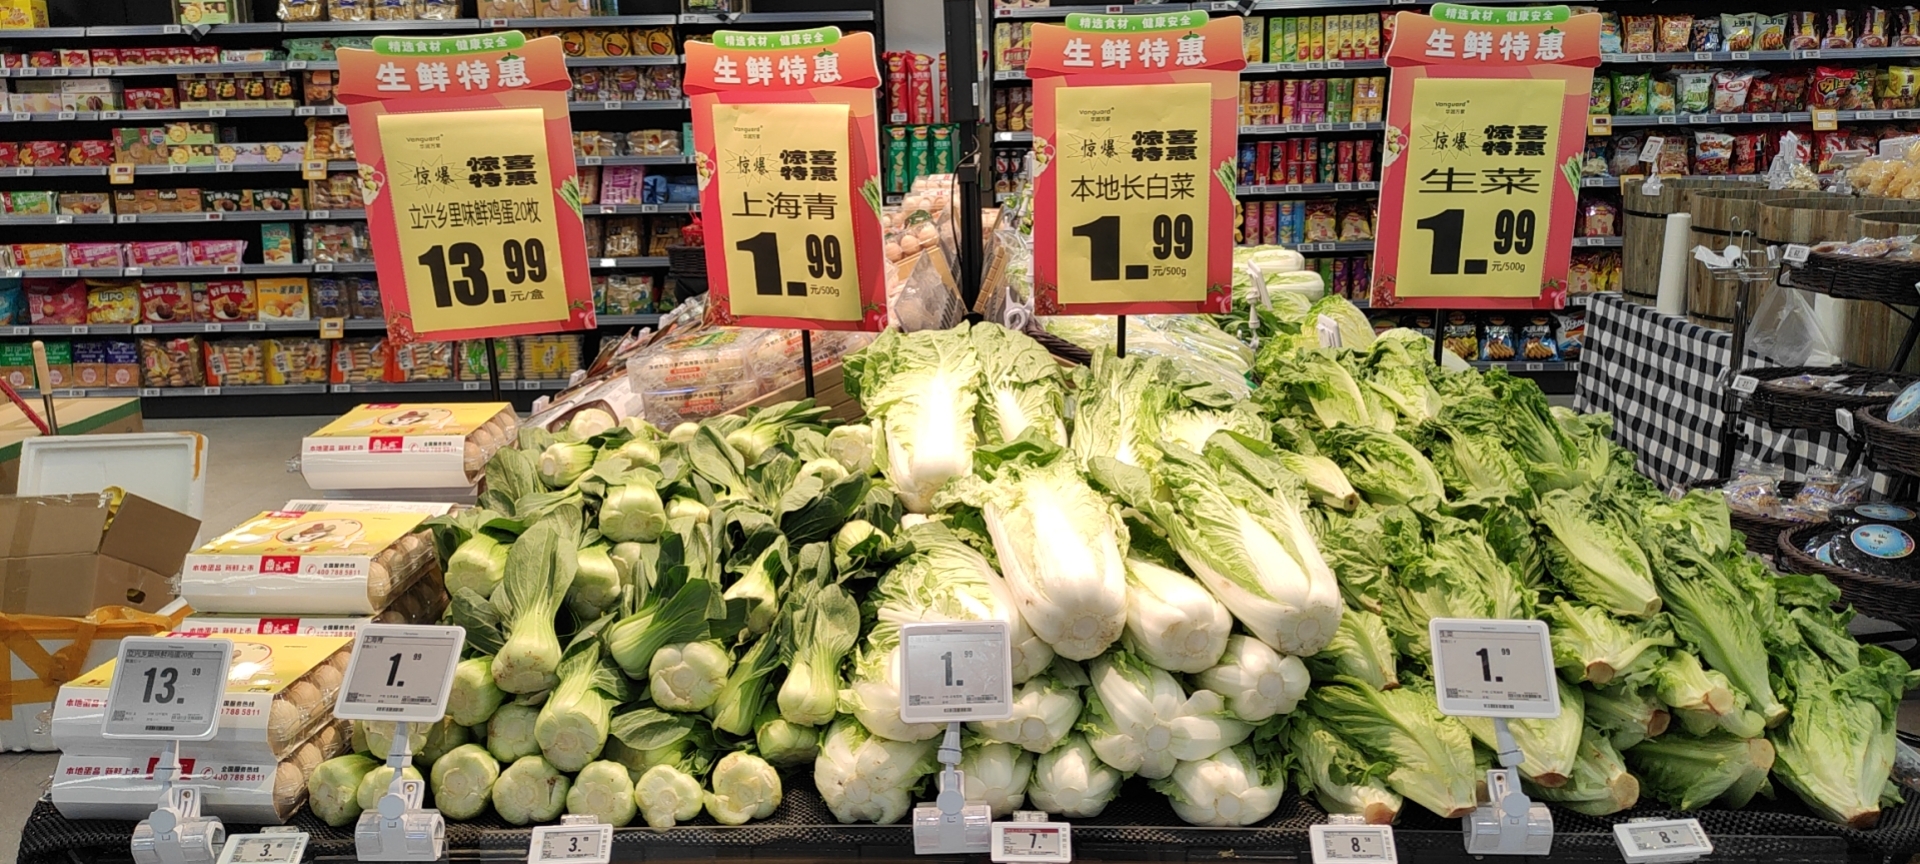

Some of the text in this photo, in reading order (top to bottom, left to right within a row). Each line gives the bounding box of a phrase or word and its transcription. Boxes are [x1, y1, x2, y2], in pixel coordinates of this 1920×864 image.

[1063, 36, 1208, 69] 生鲜特惠
[1425, 28, 1566, 62] 生鲜特惠
[376, 56, 531, 92] 生鲜特惠
[714, 52, 842, 85] 生鲜特惠
[1131, 130, 1197, 146] 惊喜
[1433, 131, 1469, 151] 惊爆
[1482, 125, 1548, 141] 惊喜
[1080, 139, 1118, 159] 惊爆
[1131, 146, 1198, 162] 特惠
[1482, 141, 1546, 156] 特惠
[466, 154, 536, 172] 惊喜
[736, 156, 770, 175] 惊爆
[779, 150, 837, 166] 惊喜
[413, 165, 454, 186] 惊爆
[468, 171, 538, 188] 特惠
[780, 166, 838, 181] 特惠
[1419, 167, 1541, 194] 生菜
[1070, 173, 1196, 202] 本地长白菜
[732, 191, 838, 220] 上海青
[408, 198, 541, 230] 立兴乡里味鲜鸡蛋20枚
[1152, 266, 1187, 278] 元/500g
[1491, 261, 1526, 273] 元/500g
[100, 292, 124, 301] LIPO
[510, 288, 545, 302] 元/盒
[810, 285, 840, 297] 元/500g
[193, 564, 222, 572] 本地蛋品
[65, 698, 99, 708] 本地蛋品
[242, 708, 260, 716] 5811
[65, 766, 140, 776] 本地蛋品 新鲜上市
[221, 765, 259, 773] 全国服务热线
[228, 773, 243, 781] 788
[245, 773, 265, 781] 5811
